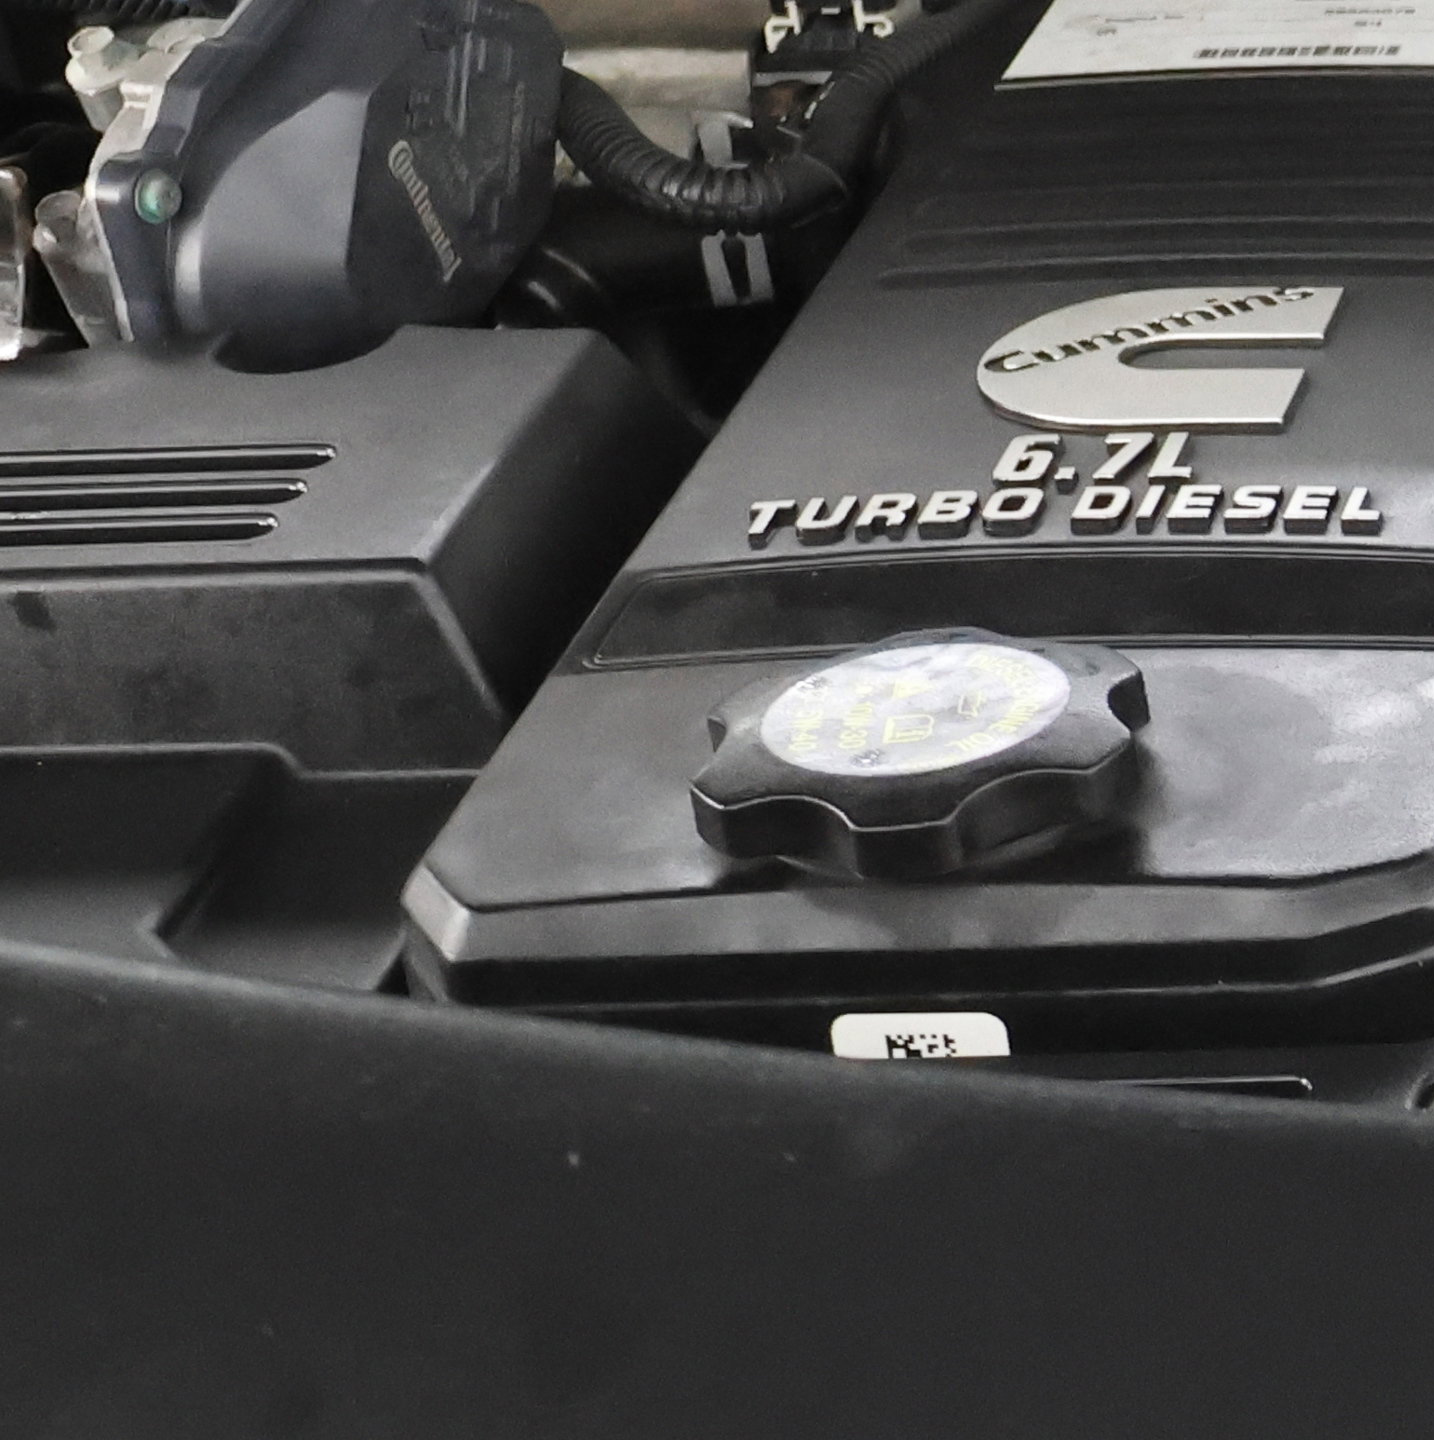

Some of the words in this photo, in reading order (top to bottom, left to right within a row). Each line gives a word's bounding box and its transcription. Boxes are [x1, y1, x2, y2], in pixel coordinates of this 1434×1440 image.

[983, 286, 1316, 373] Cummins
[990, 432, 1194, 488] 6.7L
[747, 486, 1046, 542] TURBO
[1070, 483, 1384, 536] DIESEL
[944, 731, 996, 751] OIL
